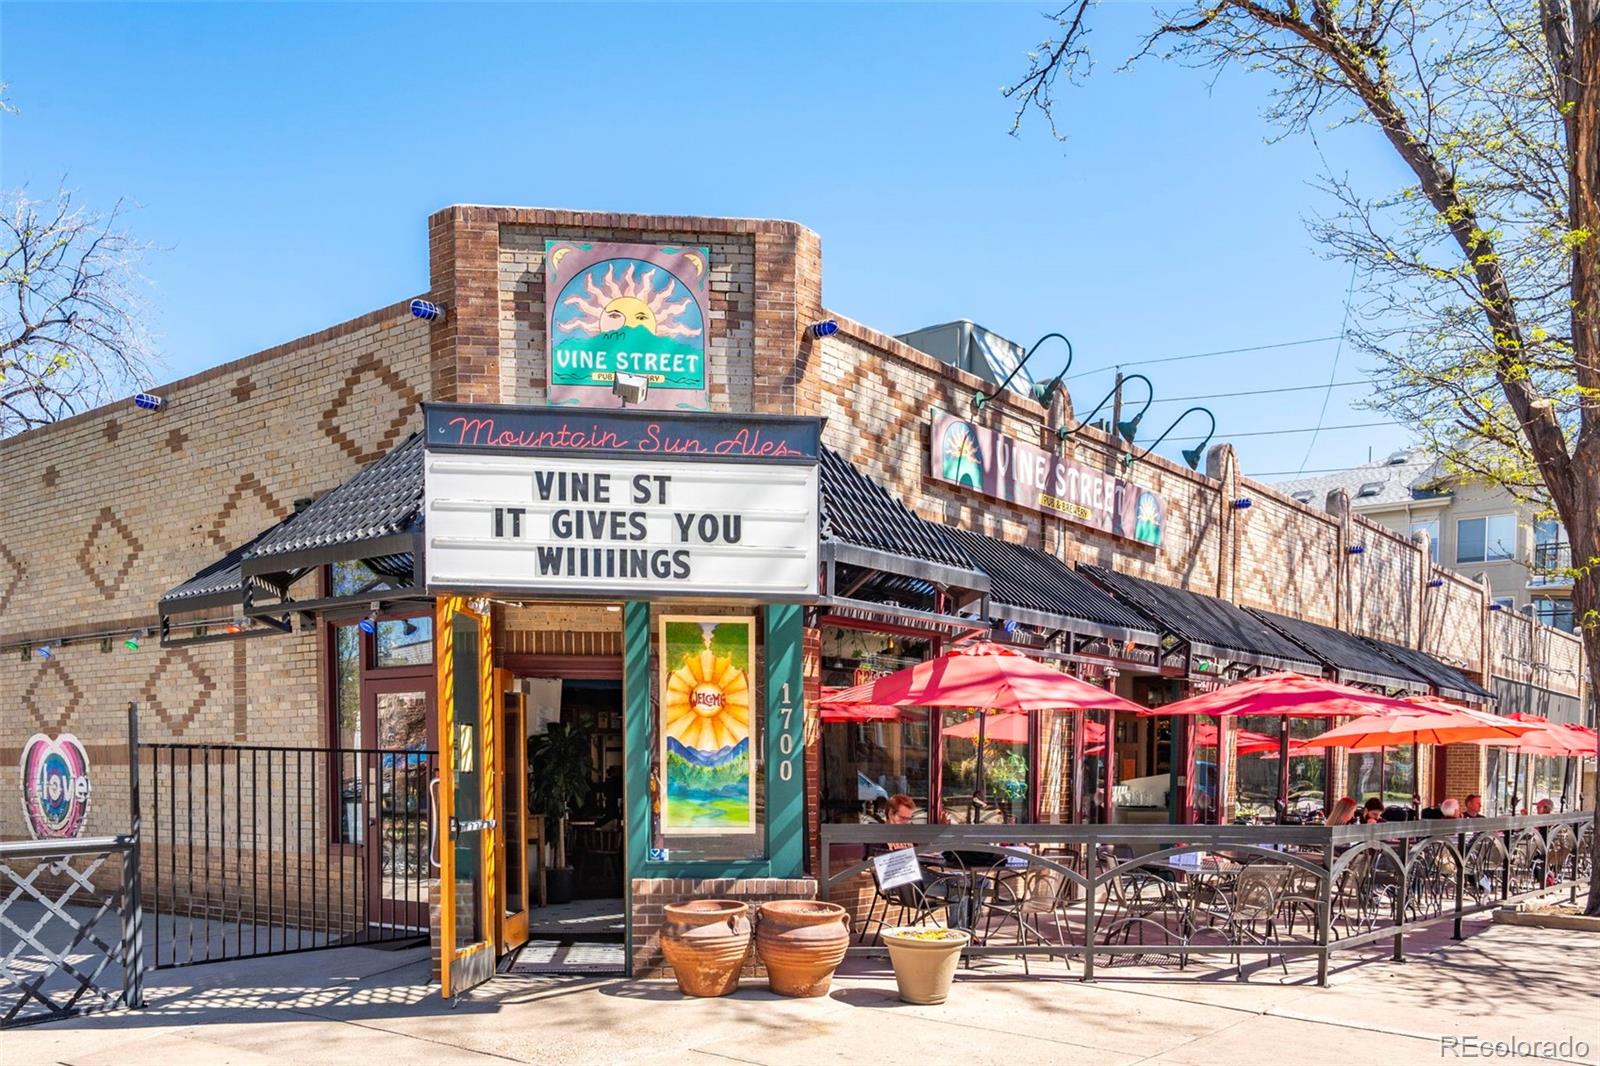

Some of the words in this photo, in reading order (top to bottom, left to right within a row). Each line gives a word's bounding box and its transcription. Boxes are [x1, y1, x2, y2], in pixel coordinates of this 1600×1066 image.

[556, 349, 607, 371] VINE
[615, 351, 699, 373] STREET
[447, 416, 629, 449] Mountain
[638, 424, 708, 455] Sun
[713, 428, 801, 456] Ales
[534, 470, 611, 503] VINE
[633, 474, 672, 504] ST
[996, 440, 1046, 490] VINE
[1055, 463, 1126, 516] STREET
[1042, 494, 1055, 508] PUB
[1061, 502, 1089, 519] BREWERY
[495, 507, 526, 538] IT
[552, 510, 648, 541] GIVES
[675, 513, 743, 544] YOU
[537, 547, 691, 578] WIIIIINGS
[689, 689, 726, 709] WELCOME
[780, 683, 792, 782] 1700
[42, 763, 88, 802] love
